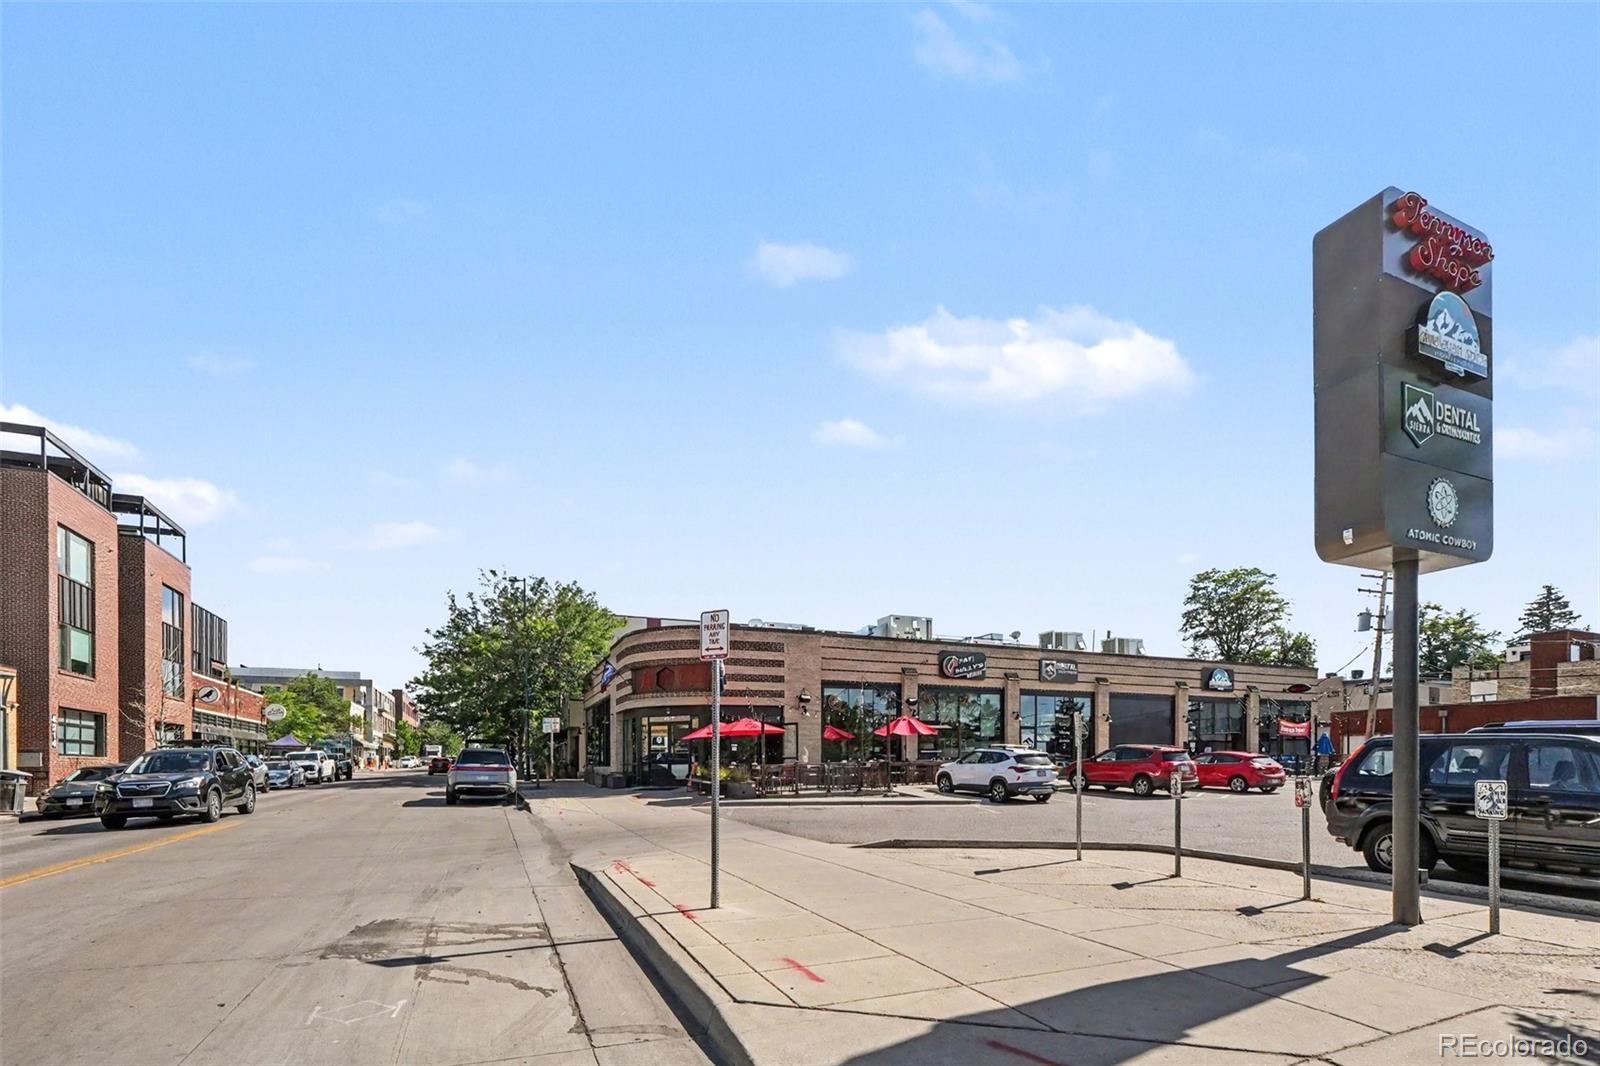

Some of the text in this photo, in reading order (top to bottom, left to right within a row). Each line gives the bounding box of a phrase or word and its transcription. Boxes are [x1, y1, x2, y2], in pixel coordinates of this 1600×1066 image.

[1436, 401, 1480, 432] DENTAL
[1409, 420, 1431, 434] SIERRA
[1407, 528, 1477, 550] ATOMIC COWBOY
[710, 613, 720, 622] NO
[704, 622, 725, 631] PARKING
